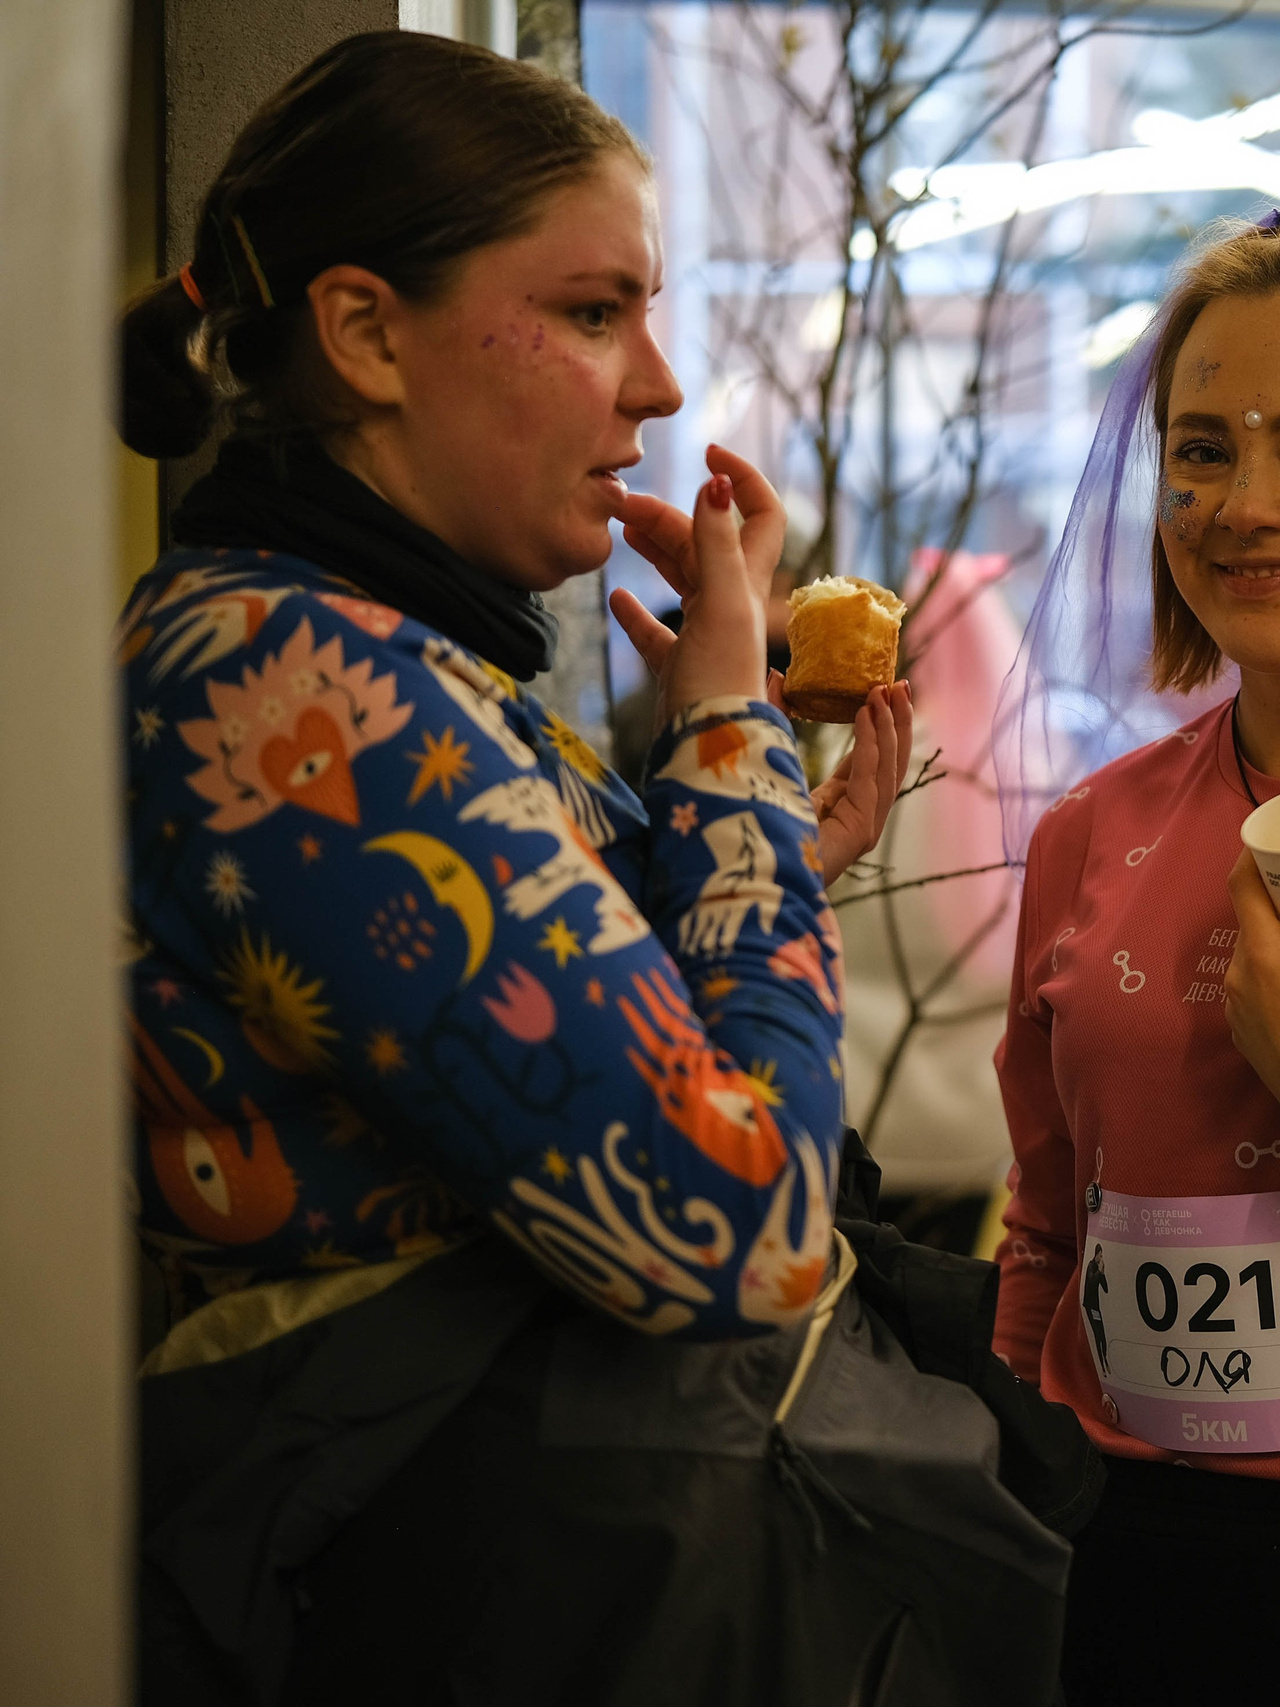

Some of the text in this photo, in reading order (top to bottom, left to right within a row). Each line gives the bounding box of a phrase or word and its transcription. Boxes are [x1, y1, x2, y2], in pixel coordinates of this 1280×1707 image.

[1208, 928, 1239, 948] БЕГ
[1196, 955, 1230, 974] КАК
[1182, 982, 1228, 1003] ДЕВЧ
[1152, 1209, 1192, 1218] БЕГАЕШЬ
[1153, 1219, 1171, 1227] КАК
[1154, 1227, 1202, 1236] ДЕВЧОНКА
[1136, 1260, 1276, 1332] 021
[1161, 1346, 1251, 1393] ОЛЯ
